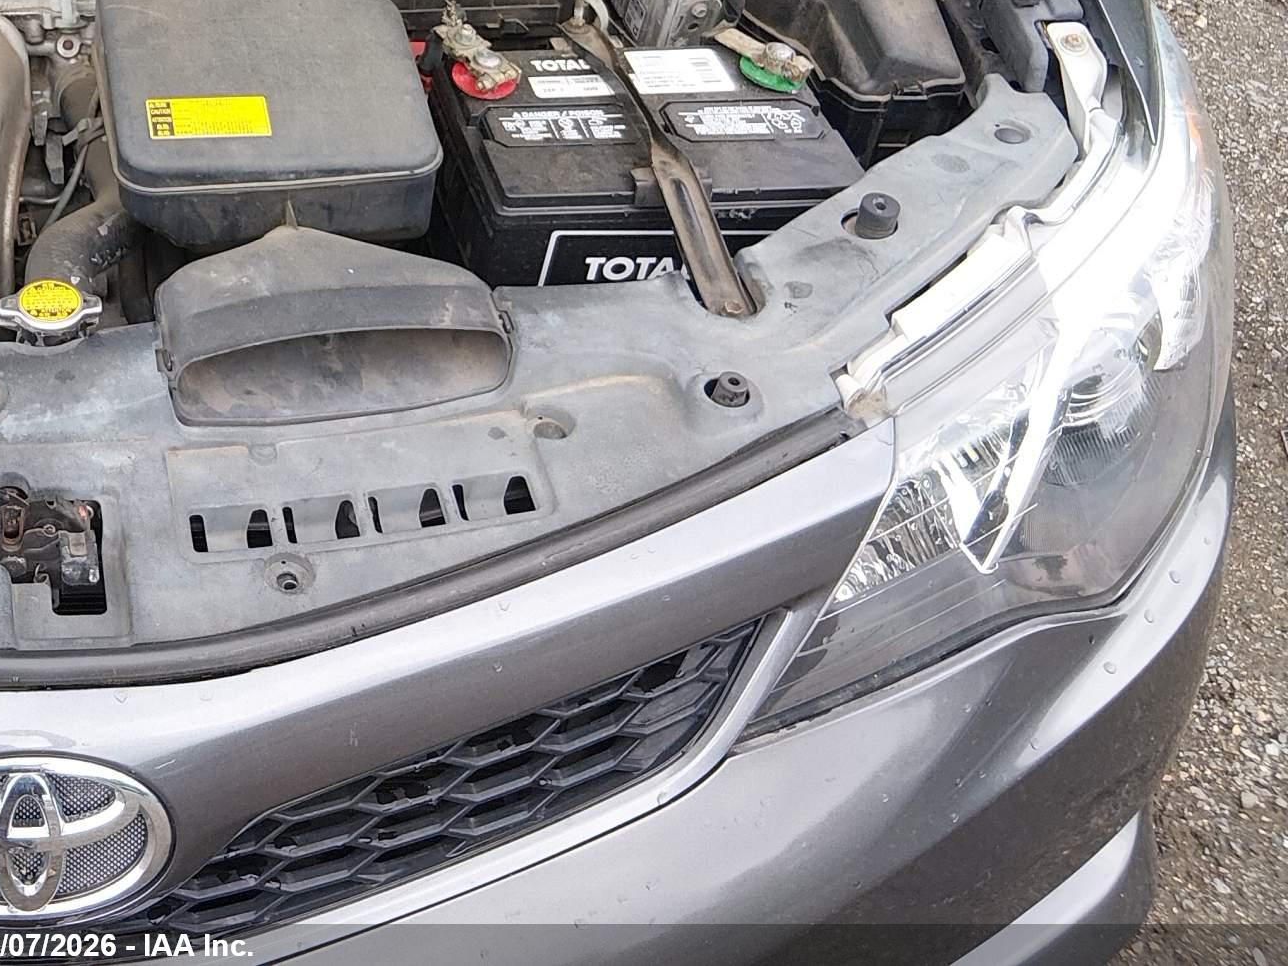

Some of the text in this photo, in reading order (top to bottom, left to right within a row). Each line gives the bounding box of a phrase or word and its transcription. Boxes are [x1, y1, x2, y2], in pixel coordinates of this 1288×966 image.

[530, 59, 591, 72] TOTAL
[521, 111, 560, 119] DANGER
[568, 110, 605, 118] POISON
[585, 256, 690, 282] TOTA
